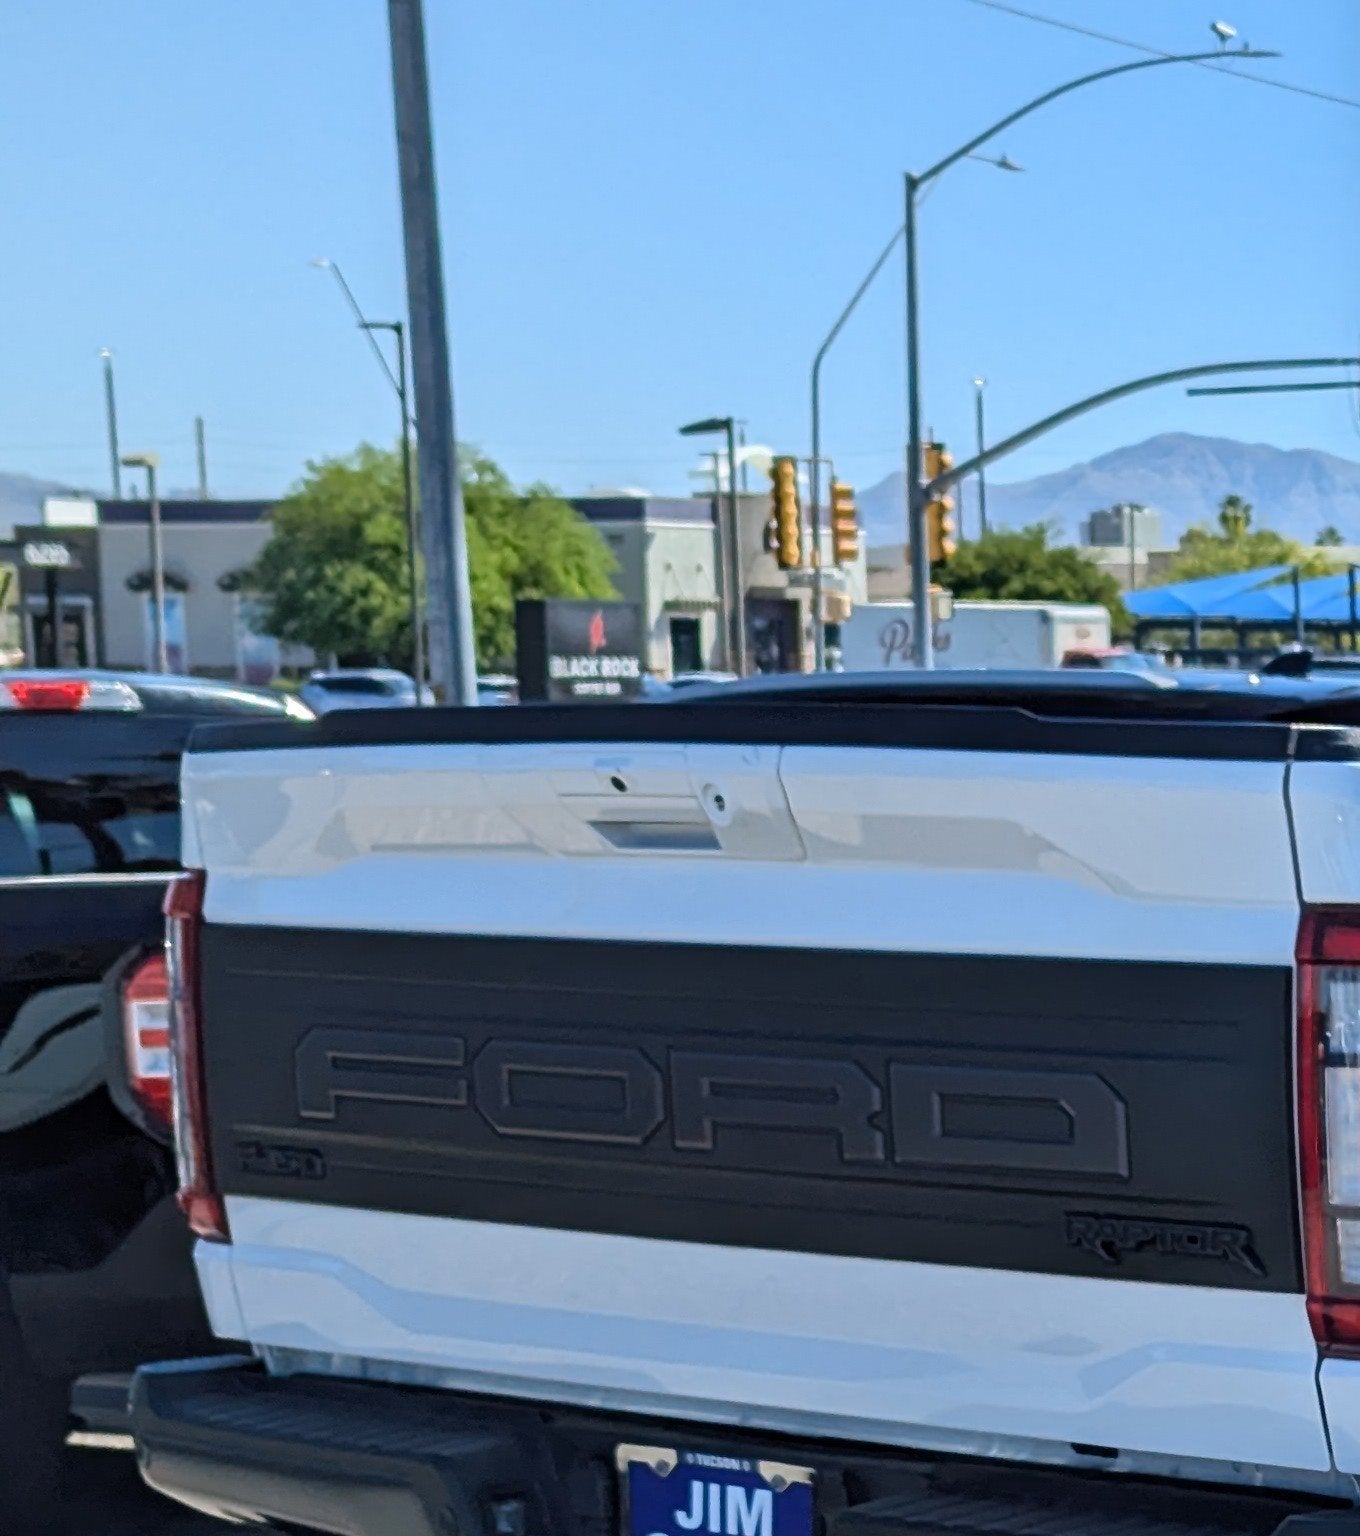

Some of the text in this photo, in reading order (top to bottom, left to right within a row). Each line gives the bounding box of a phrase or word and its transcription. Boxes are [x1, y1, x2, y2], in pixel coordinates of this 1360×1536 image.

[549, 655, 640, 679] BLACK ROCK
[292, 1022, 1132, 1181] FORD
[1064, 1210, 1268, 1279] RAPTOR
